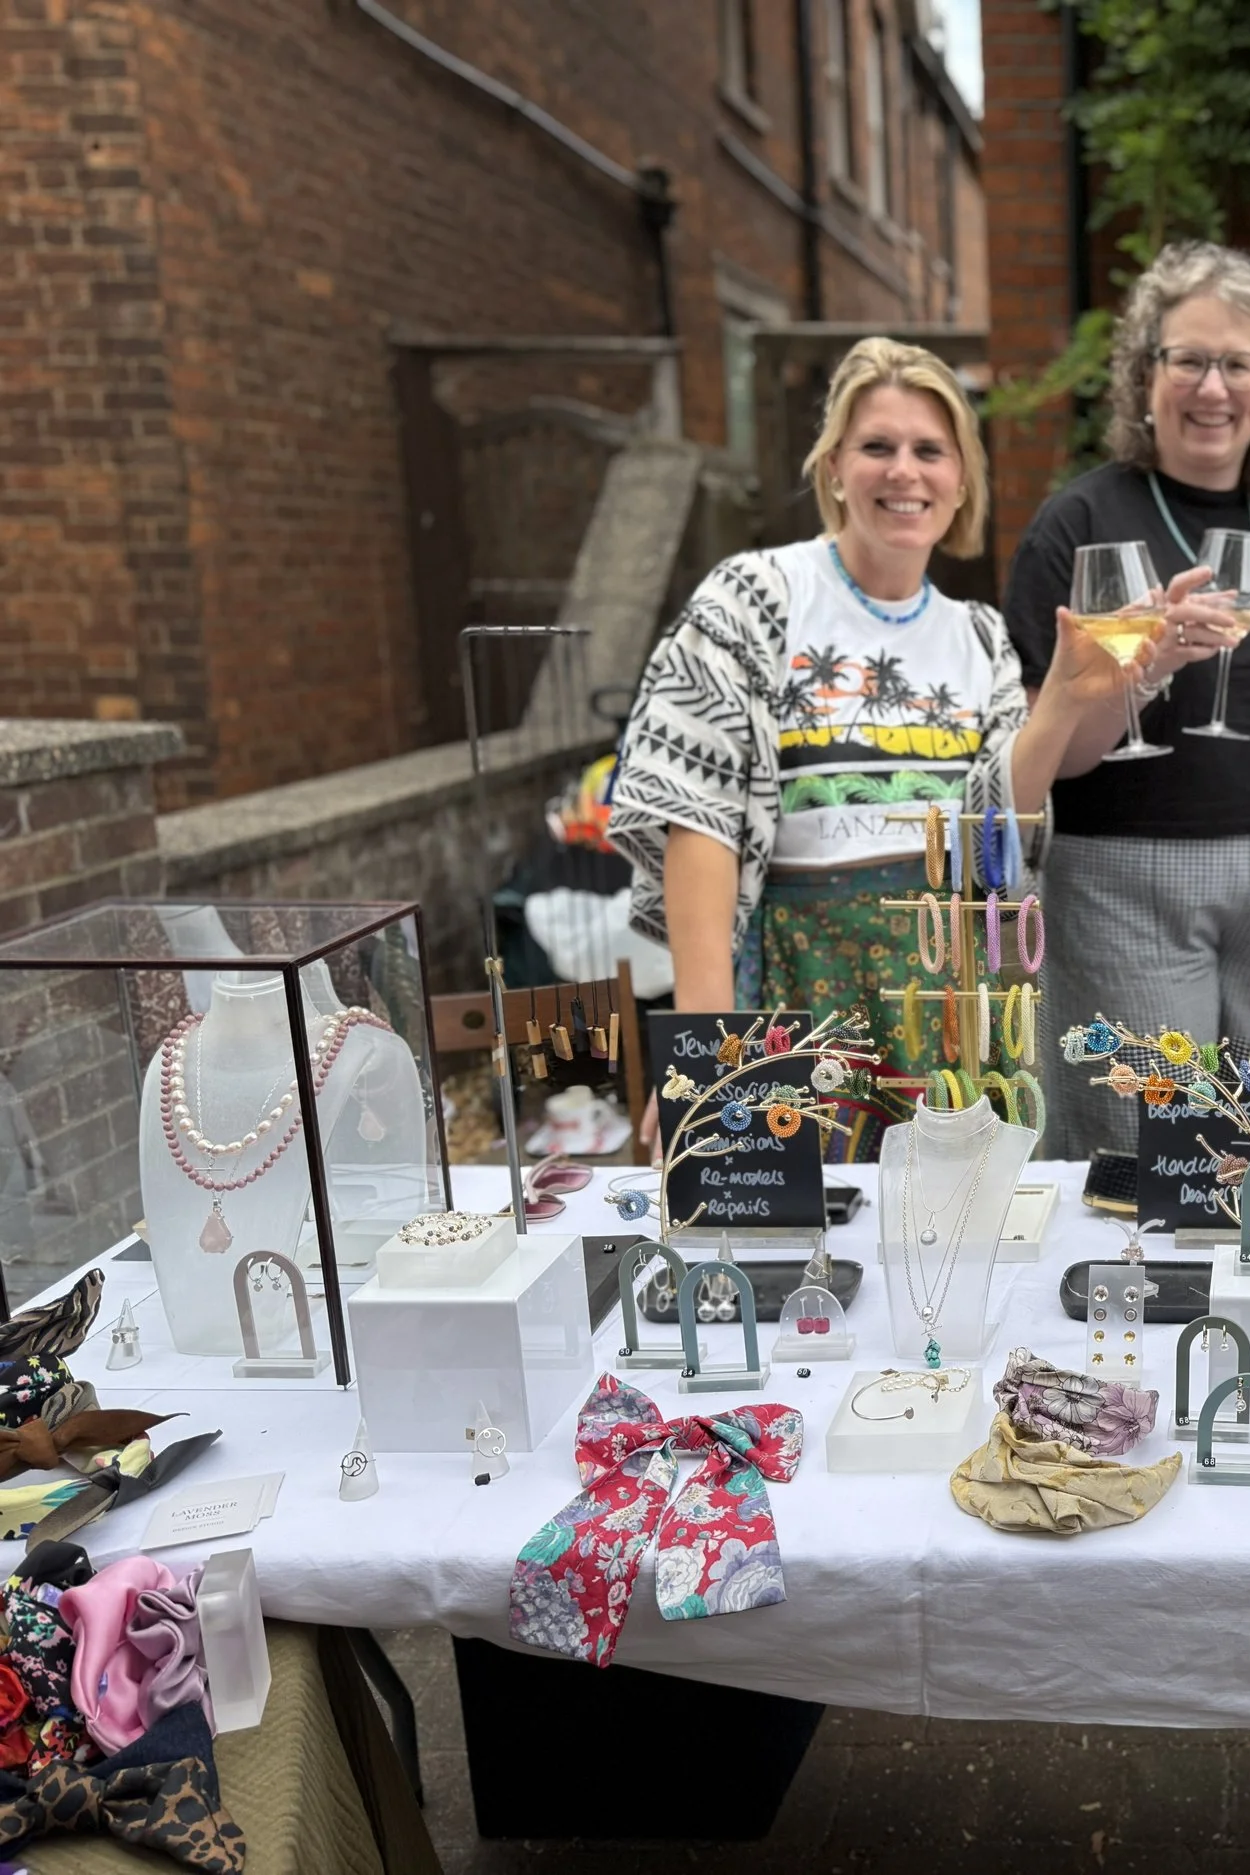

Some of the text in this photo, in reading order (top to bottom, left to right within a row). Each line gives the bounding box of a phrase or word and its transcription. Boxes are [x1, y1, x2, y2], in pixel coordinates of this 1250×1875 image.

[818, 810, 950, 840] LANZA
[1148, 1102, 1209, 1124] Bespo
[700, 1166, 786, 1186] Re-models
[708, 1197, 771, 1221] Repairs
[1178, 1416, 1189, 1425] 68
[1204, 1457, 1215, 1466] 68
[171, 1501, 238, 1517] LAVENDER
[185, 1510, 221, 1521] MOSS
